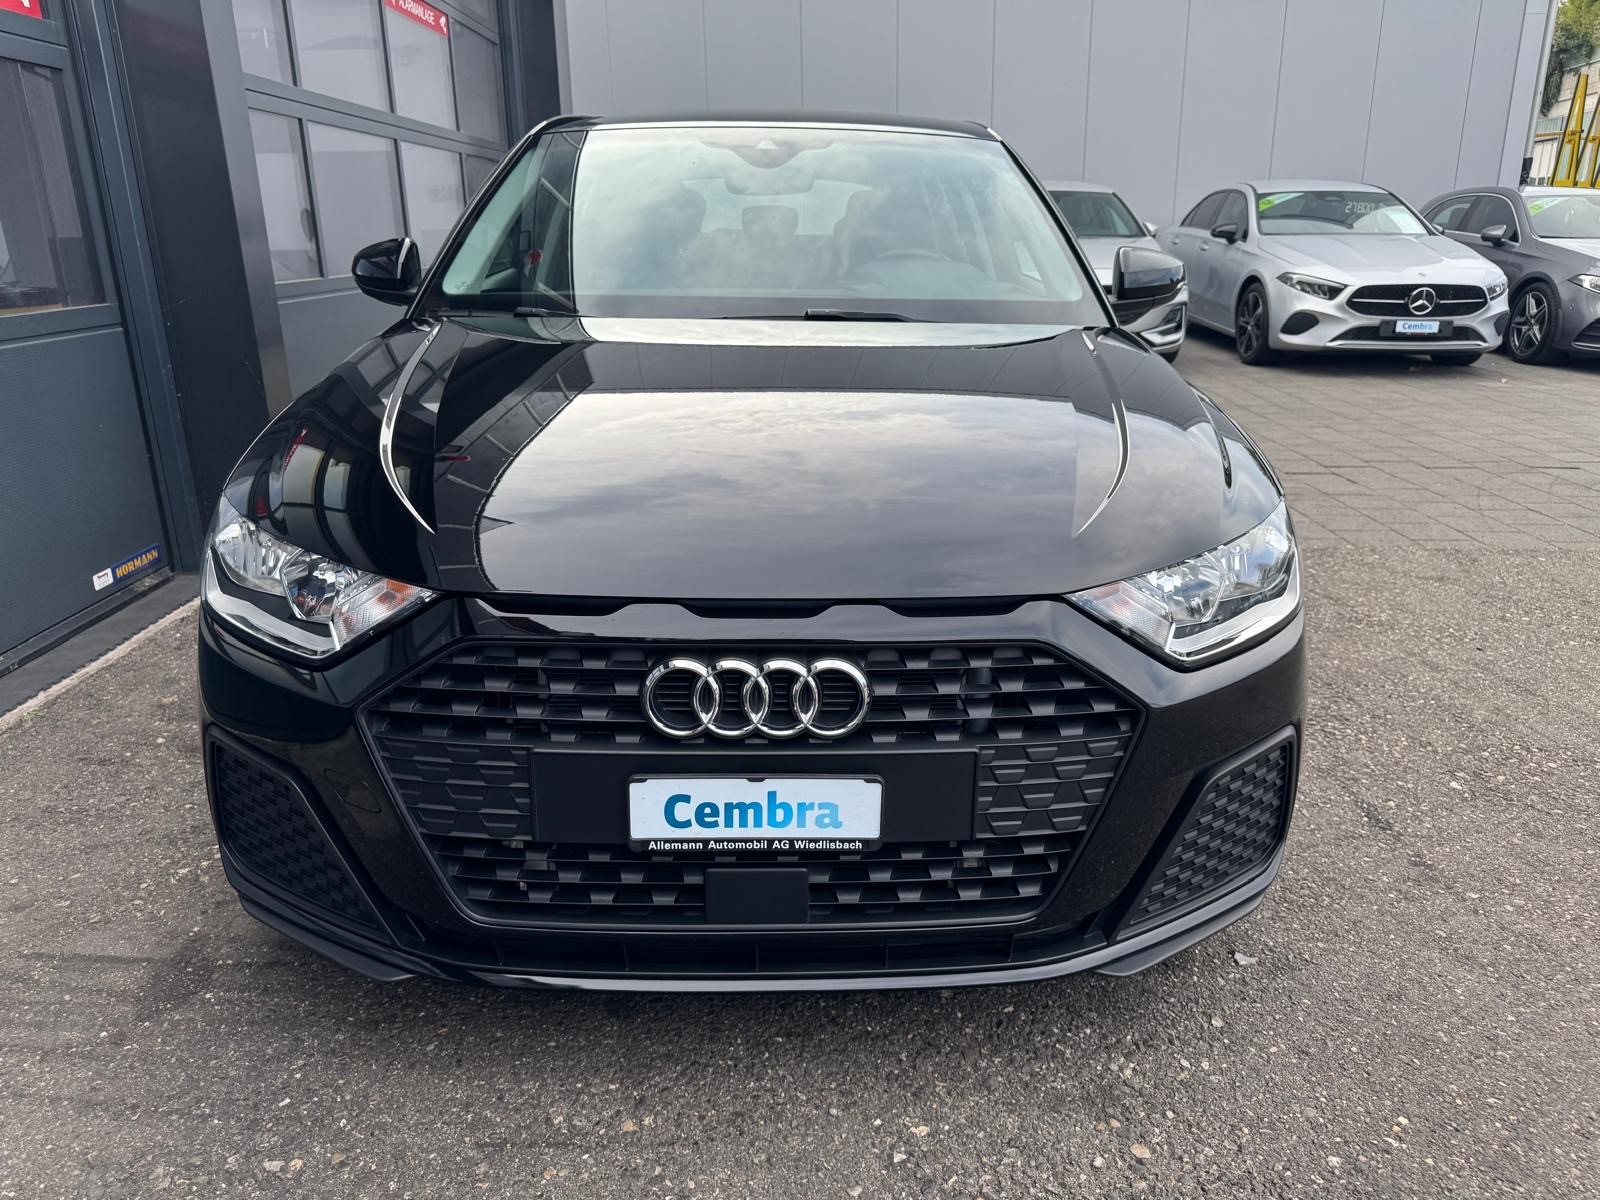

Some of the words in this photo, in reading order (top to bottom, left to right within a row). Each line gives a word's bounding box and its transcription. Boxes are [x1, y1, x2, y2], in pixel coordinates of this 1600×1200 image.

[1402, 322, 1434, 331] Cembra
[663, 790, 844, 829] Cembra
[648, 840, 704, 851] Allemann
[707, 839, 768, 850] Automobil
[772, 839, 791, 850] AG
[794, 839, 863, 850] Wiedlisbach
